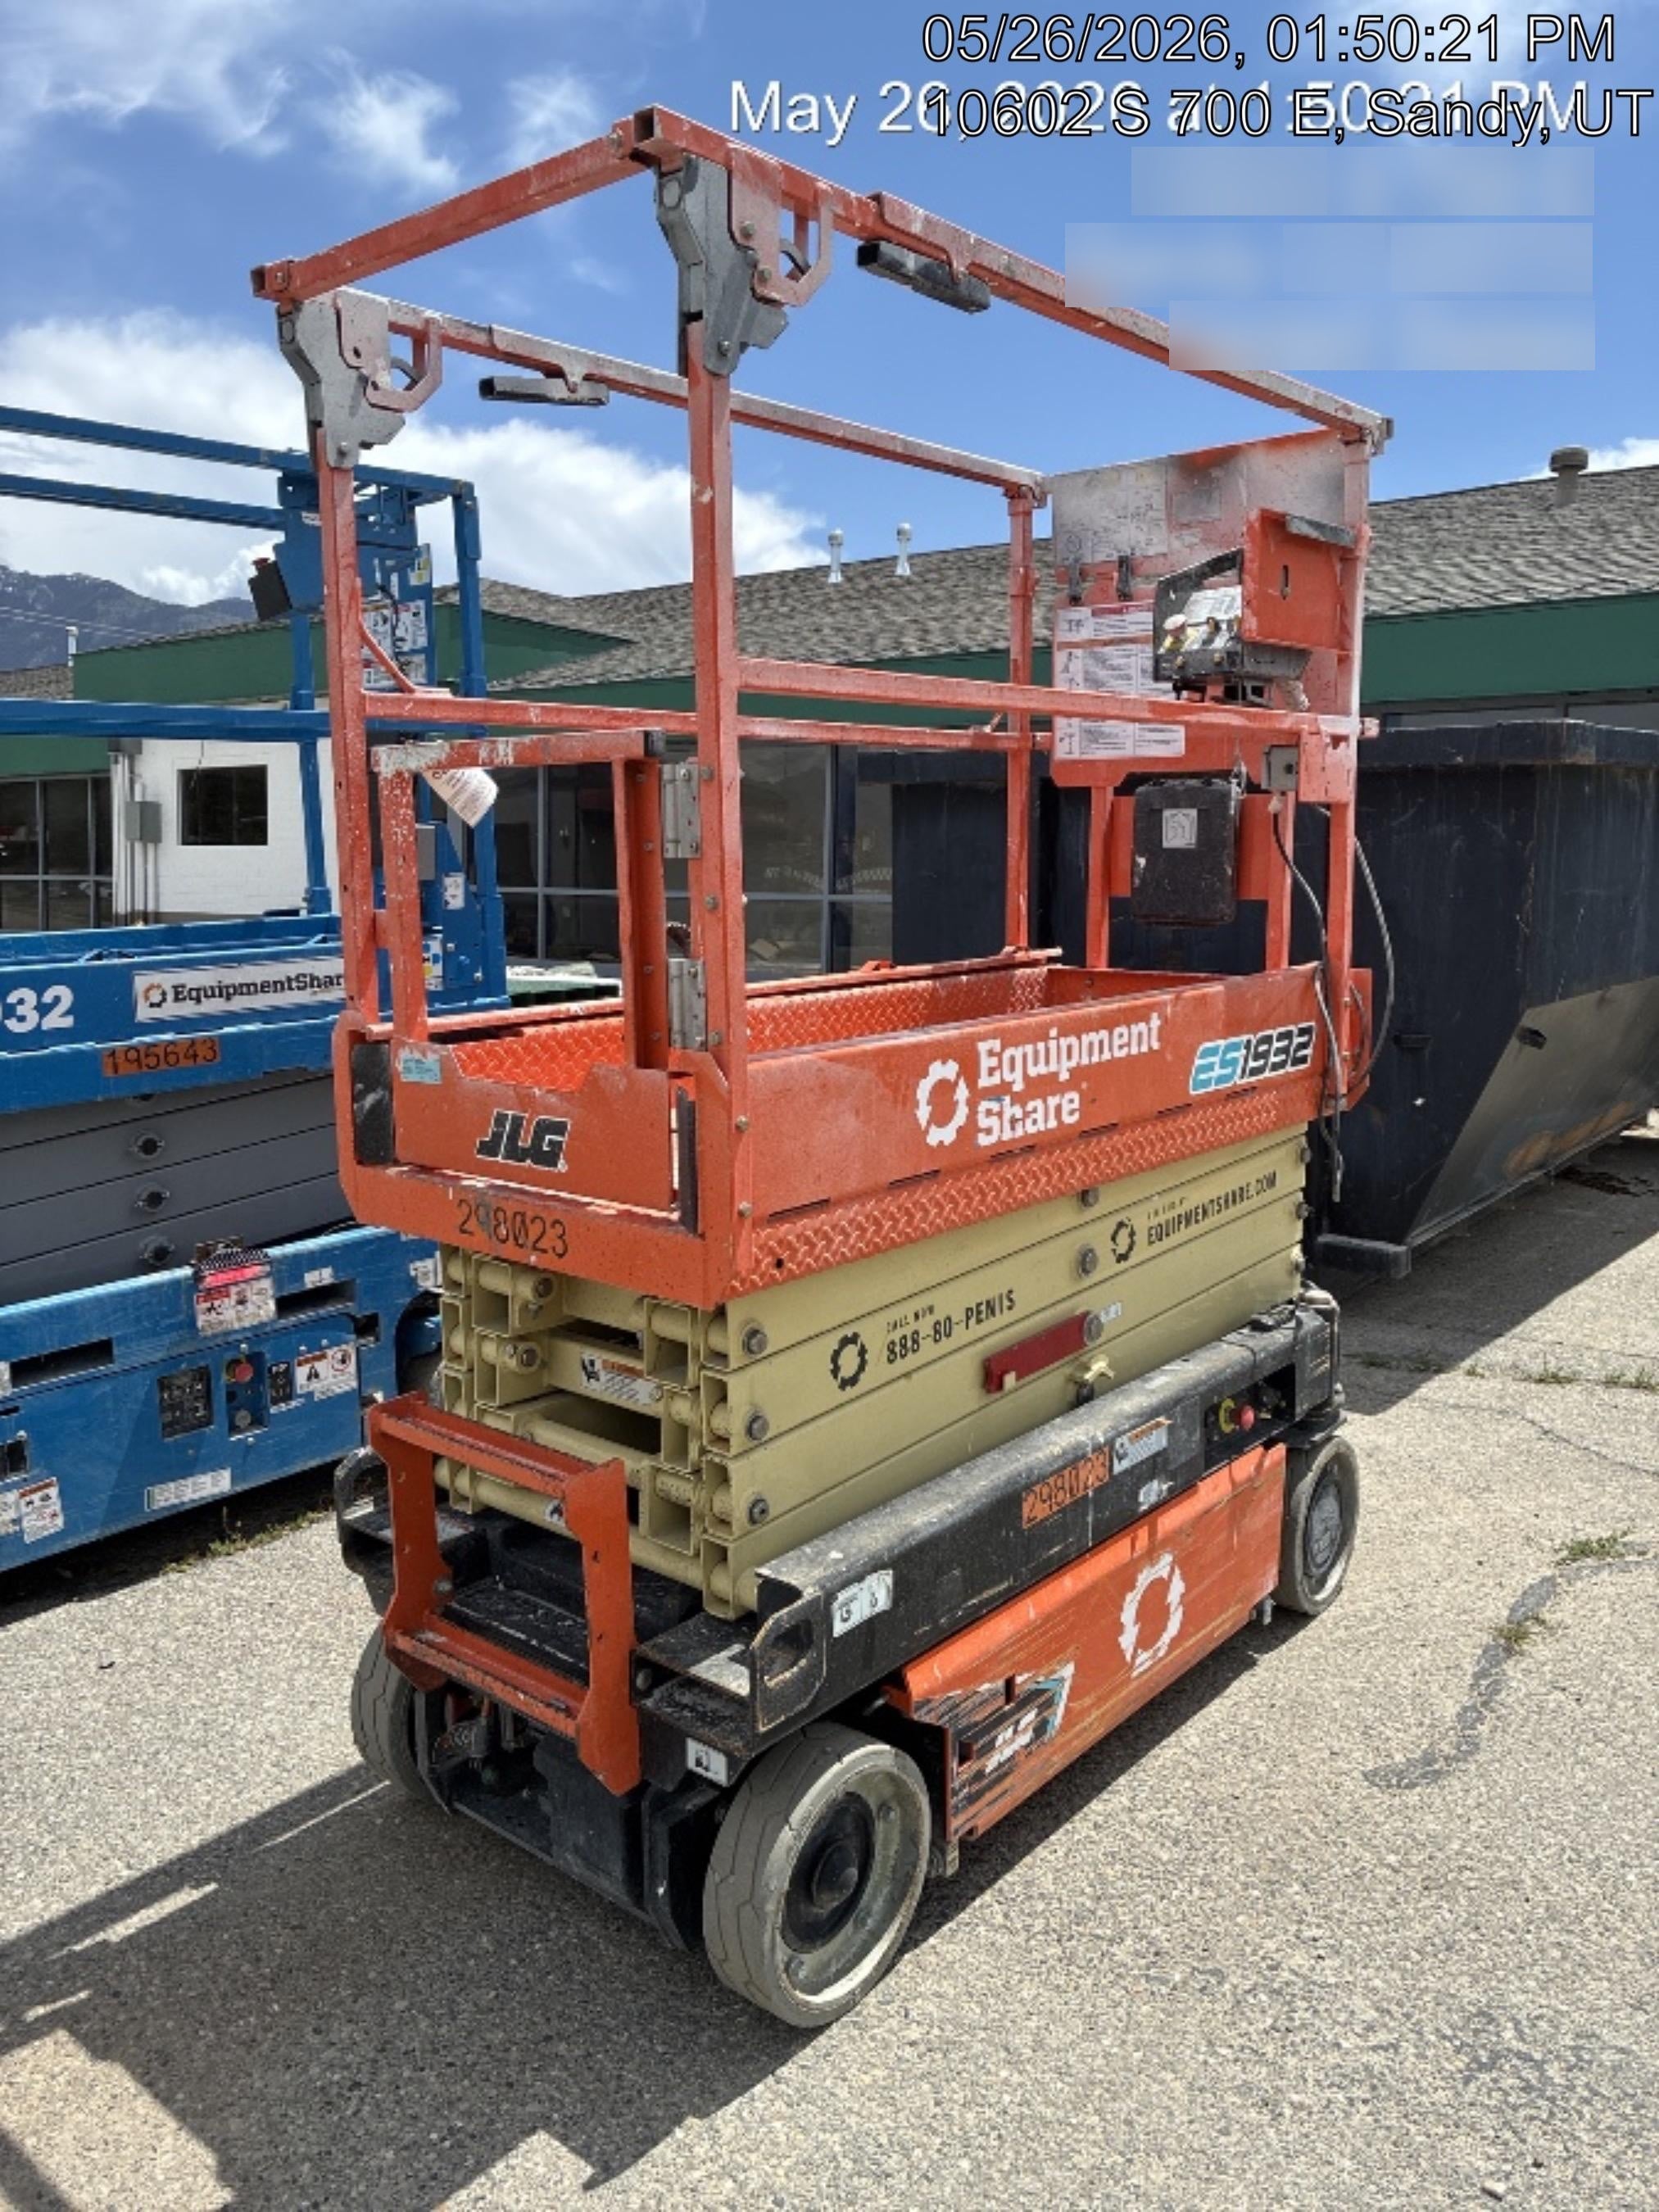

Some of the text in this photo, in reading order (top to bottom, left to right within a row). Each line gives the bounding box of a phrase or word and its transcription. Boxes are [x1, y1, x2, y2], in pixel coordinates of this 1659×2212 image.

[0, 985, 75, 1033] 32
[171, 972, 344, 1006] EquipmentShar
[106, 1037, 220, 1075] 195643
[977, 1012, 1162, 1093] Equipment
[1190, 1022, 1317, 1095] ES1932
[474, 1108, 569, 1172] JLG
[977, 1090, 1081, 1147] Share
[457, 1198, 569, 1259] 298023
[1147, 1169, 1278, 1246] EQUIPMENTSHARE.COM
